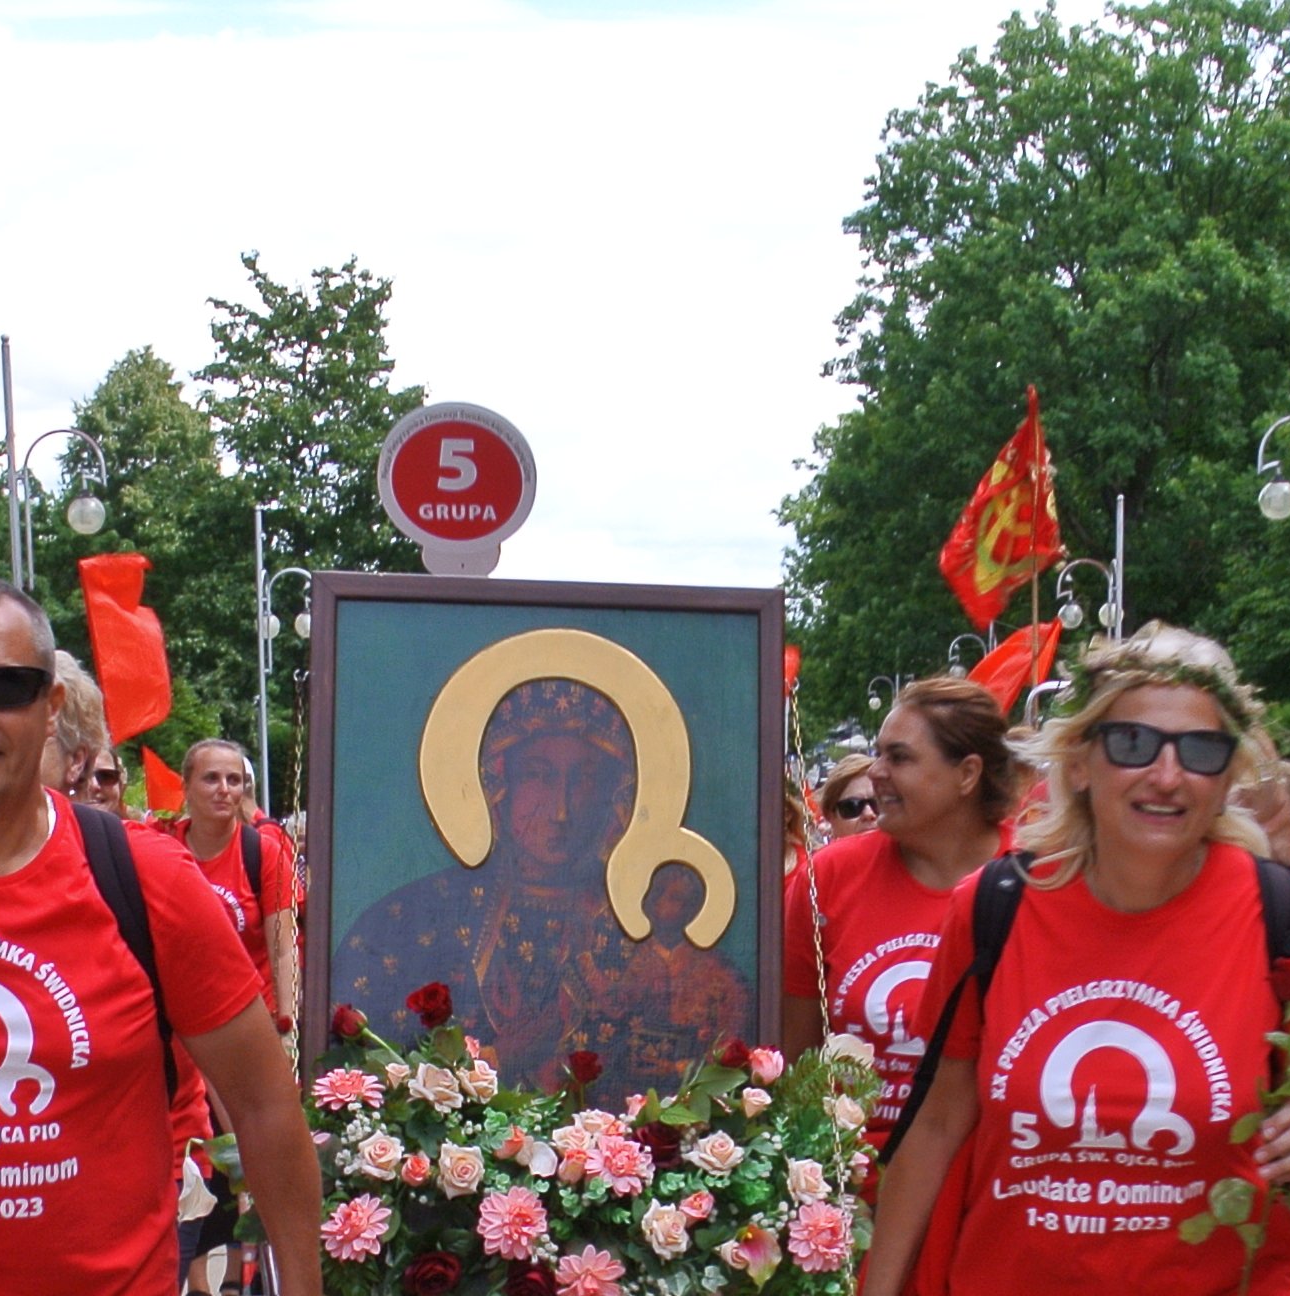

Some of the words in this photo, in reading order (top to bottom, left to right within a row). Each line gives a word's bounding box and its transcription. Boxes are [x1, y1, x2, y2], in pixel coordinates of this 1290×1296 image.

[437, 438, 478, 492] 5
[418, 503, 497, 521] GRUPA
[838, 952, 877, 994] PIESZA
[34, 962, 91, 1069] ŚWIDNICKA
[833, 997, 845, 1016] XX
[1044, 980, 1181, 1019] PIELGRZYMKA
[997, 1008, 1050, 1071] PIESZA
[1175, 1010, 1232, 1122] ŚWIDNICKA
[990, 1073, 1008, 1101] XX
[29, 1122, 60, 1142] PIO
[1011, 1111, 1041, 1151] 5
[1010, 1152, 1072, 1169] GRUPA
[1114, 1153, 1159, 1167] OJCA
[993, 1175, 1092, 1203] Laudate
[1097, 1179, 1206, 1205] Dominum
[1026, 1207, 1059, 1231] 1-8
[1064, 1214, 1107, 1234] VIII
[1112, 1216, 1171, 1232] 2023
